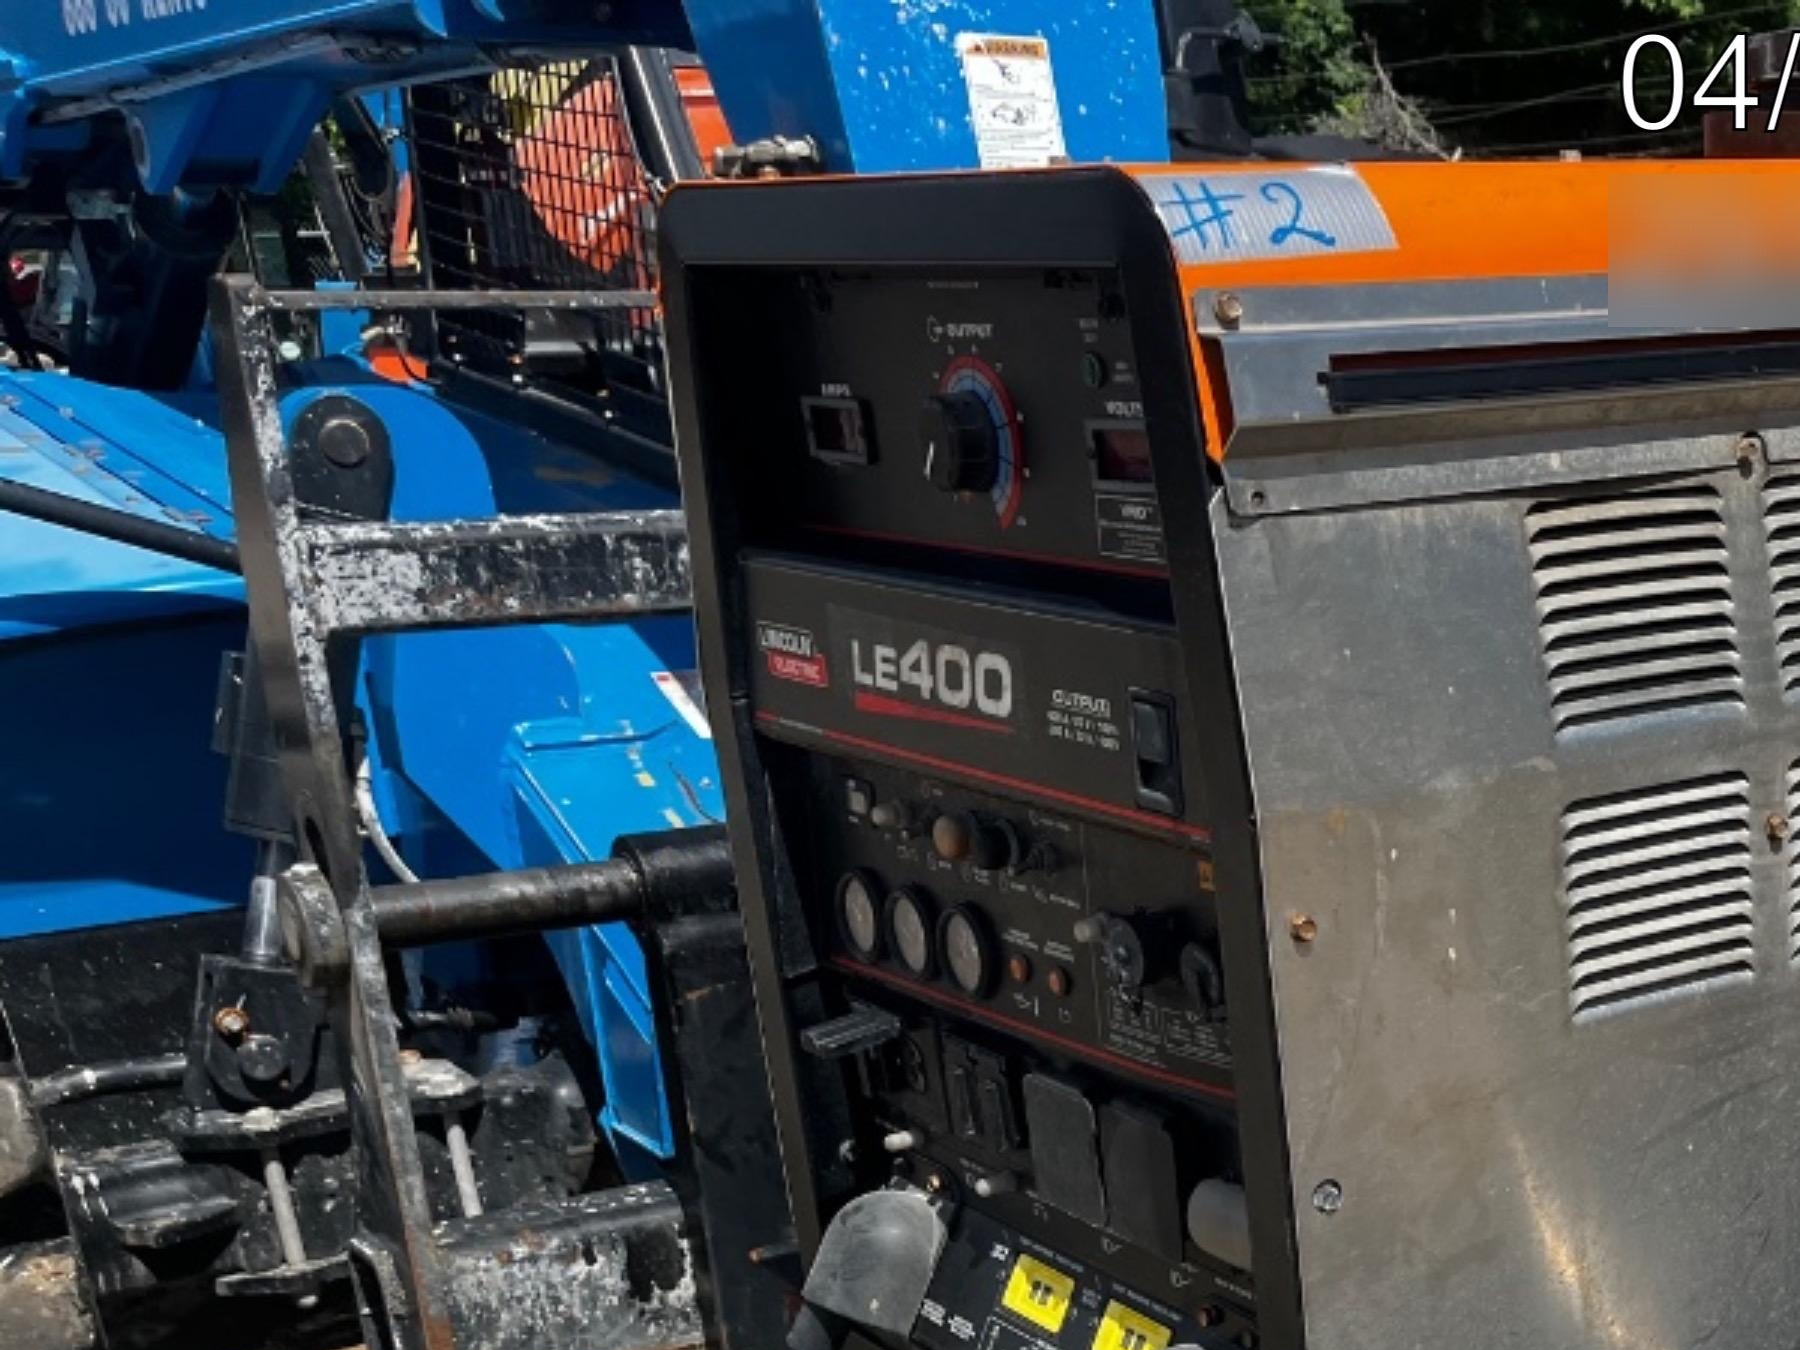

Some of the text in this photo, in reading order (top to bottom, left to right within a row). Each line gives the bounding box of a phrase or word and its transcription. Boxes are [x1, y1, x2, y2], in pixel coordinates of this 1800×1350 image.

[1160, 181, 1336, 249] # 2
[851, 638, 1013, 719] LE400
